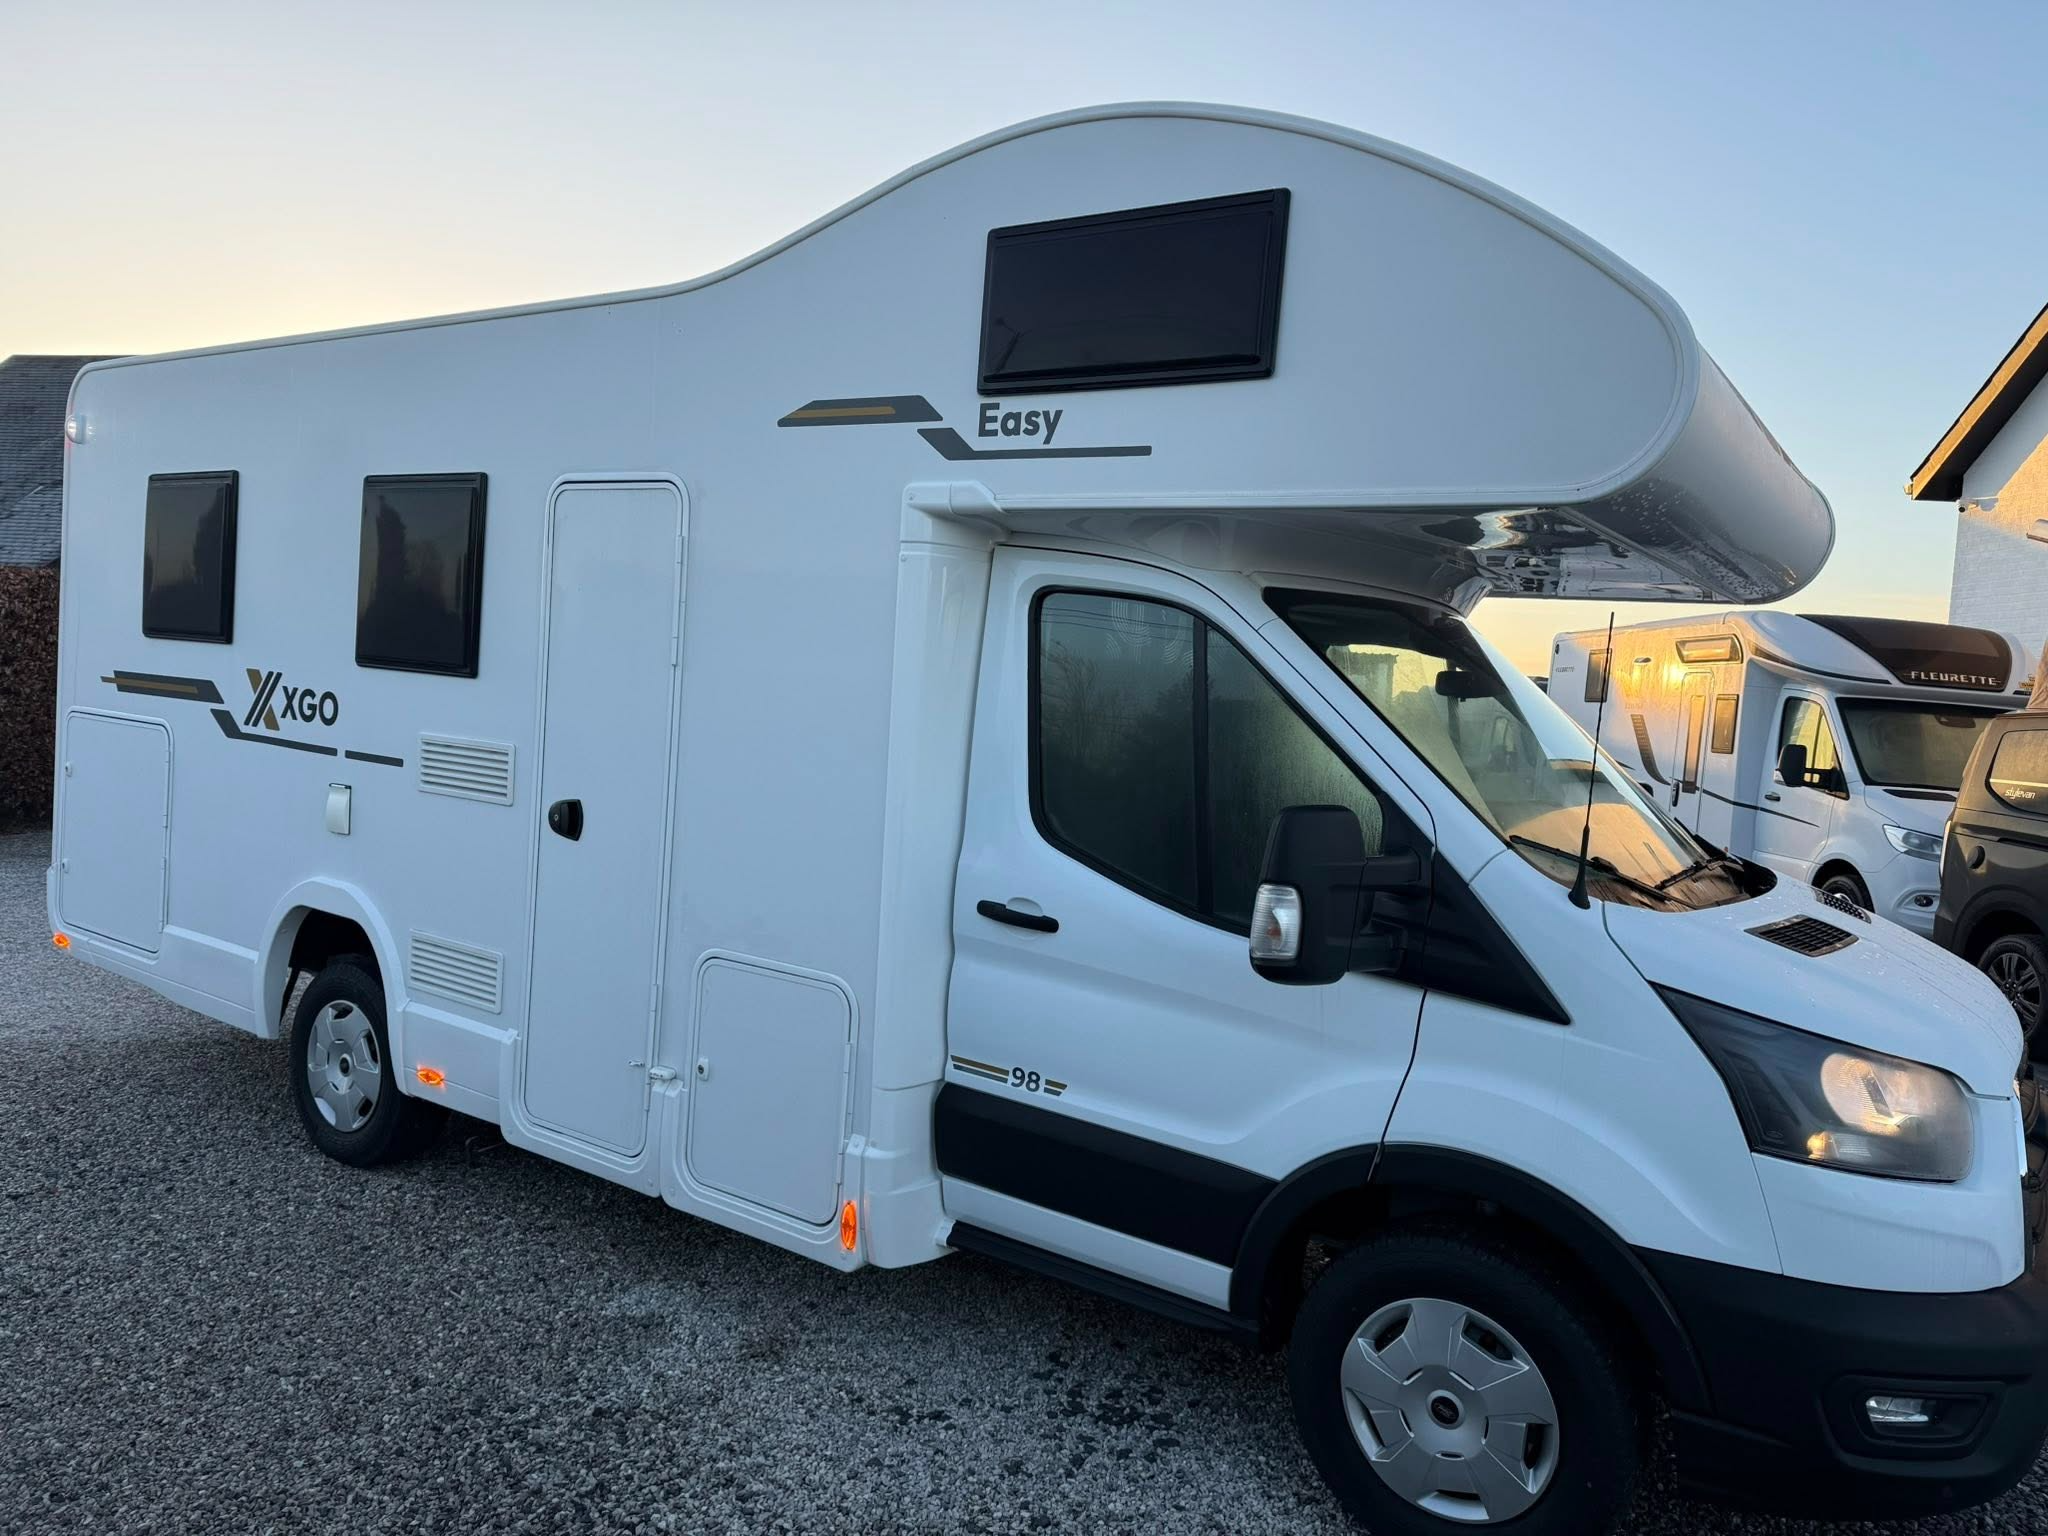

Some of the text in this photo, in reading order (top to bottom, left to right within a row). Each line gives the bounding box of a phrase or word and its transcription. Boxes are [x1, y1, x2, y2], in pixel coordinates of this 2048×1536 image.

[978, 402, 1064, 445] Easy
[1911, 671, 1997, 686] FLEURETTE
[280, 685, 339, 726] XGO
[2004, 786, 2036, 800] stylevan
[1010, 1066, 1041, 1092] 98
